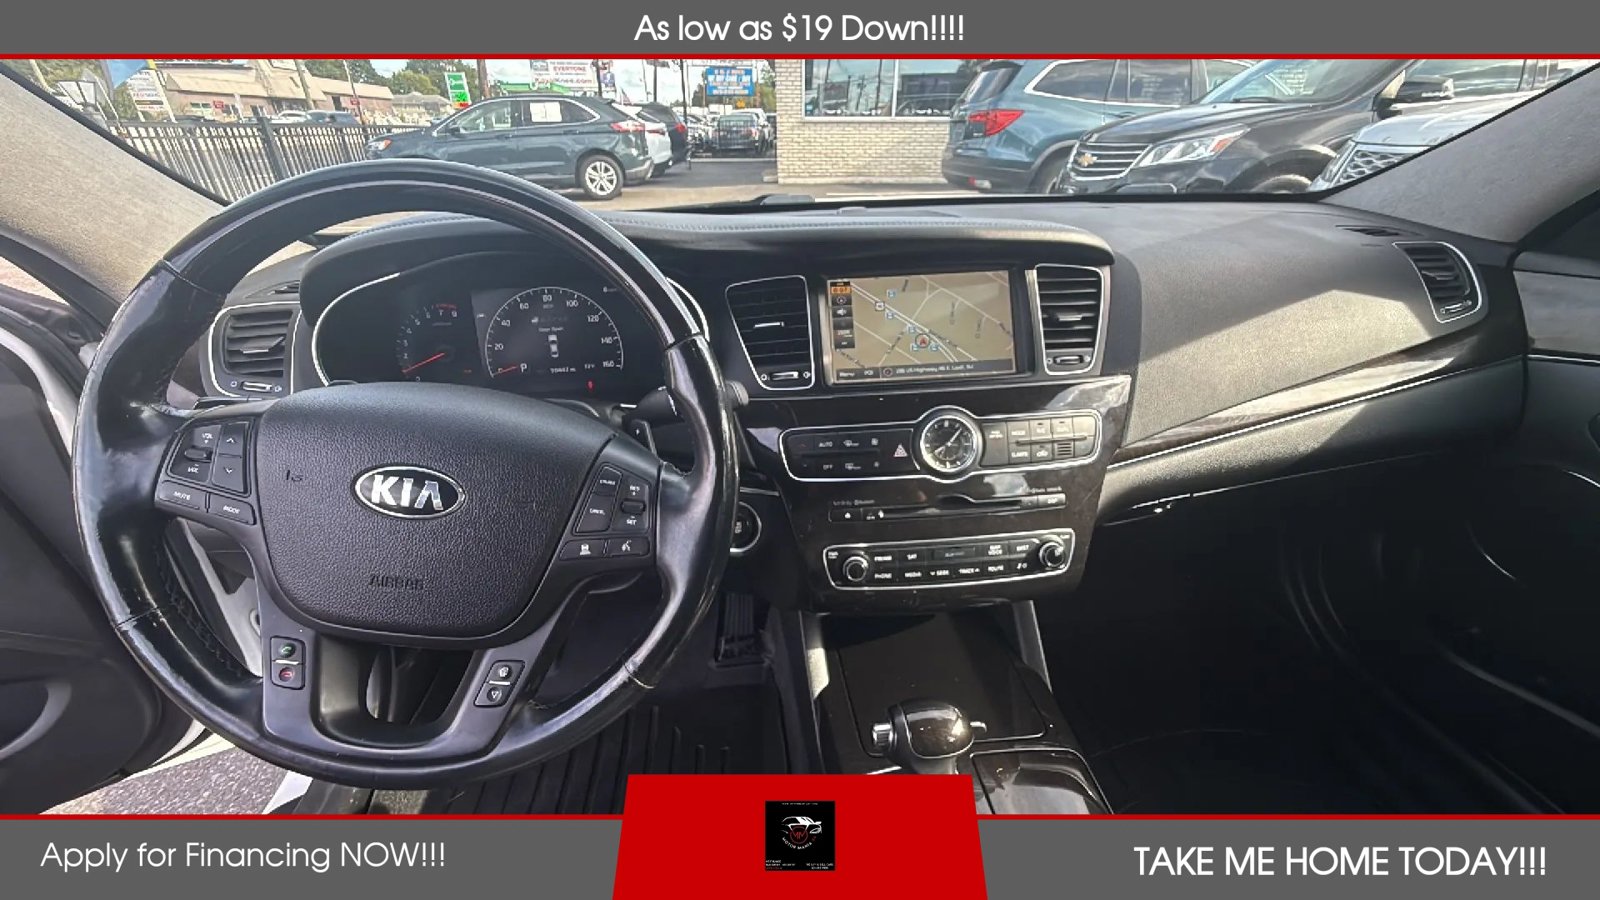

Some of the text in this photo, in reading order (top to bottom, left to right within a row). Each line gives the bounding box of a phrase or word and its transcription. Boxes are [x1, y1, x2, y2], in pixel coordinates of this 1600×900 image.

[520, 363, 527, 373] P
[202, 432, 213, 440] VOL
[172, 491, 191, 500] MUTE
[371, 474, 443, 510] KIA
[223, 505, 241, 514] MODE
